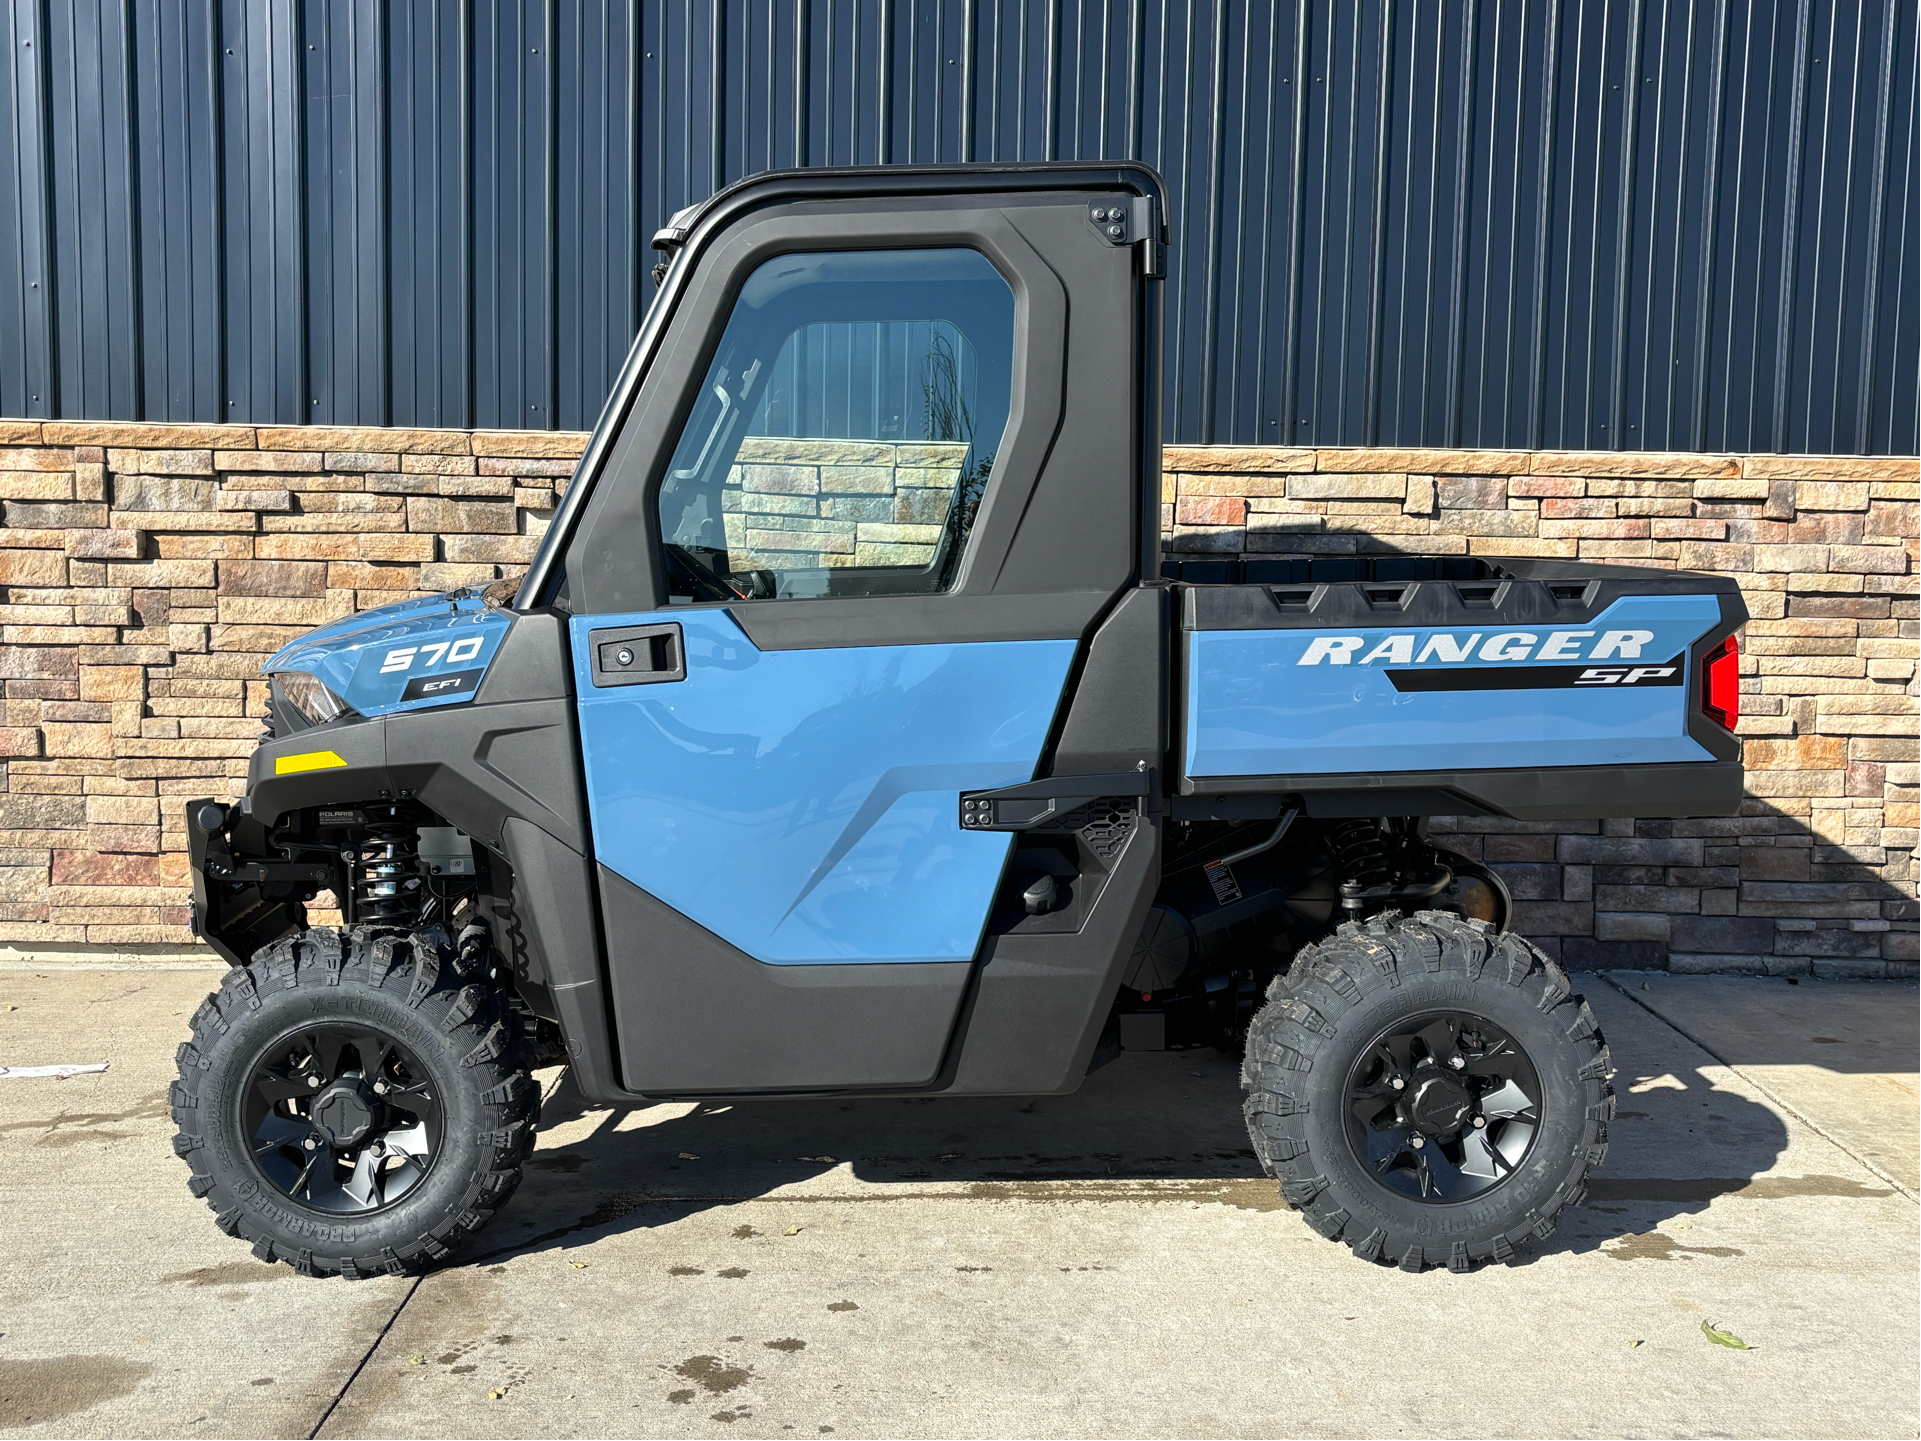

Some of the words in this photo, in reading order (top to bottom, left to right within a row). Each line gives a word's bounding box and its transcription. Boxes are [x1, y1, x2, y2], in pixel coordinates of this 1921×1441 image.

[379, 636, 484, 674] 570
[1297, 630, 1654, 666] RANGER
[422, 678, 461, 692] EFI
[1573, 667, 1677, 684] SP
[308, 995, 445, 1060] X-TERRAIN
[1339, 983, 1476, 1051] X-TERRAIN
